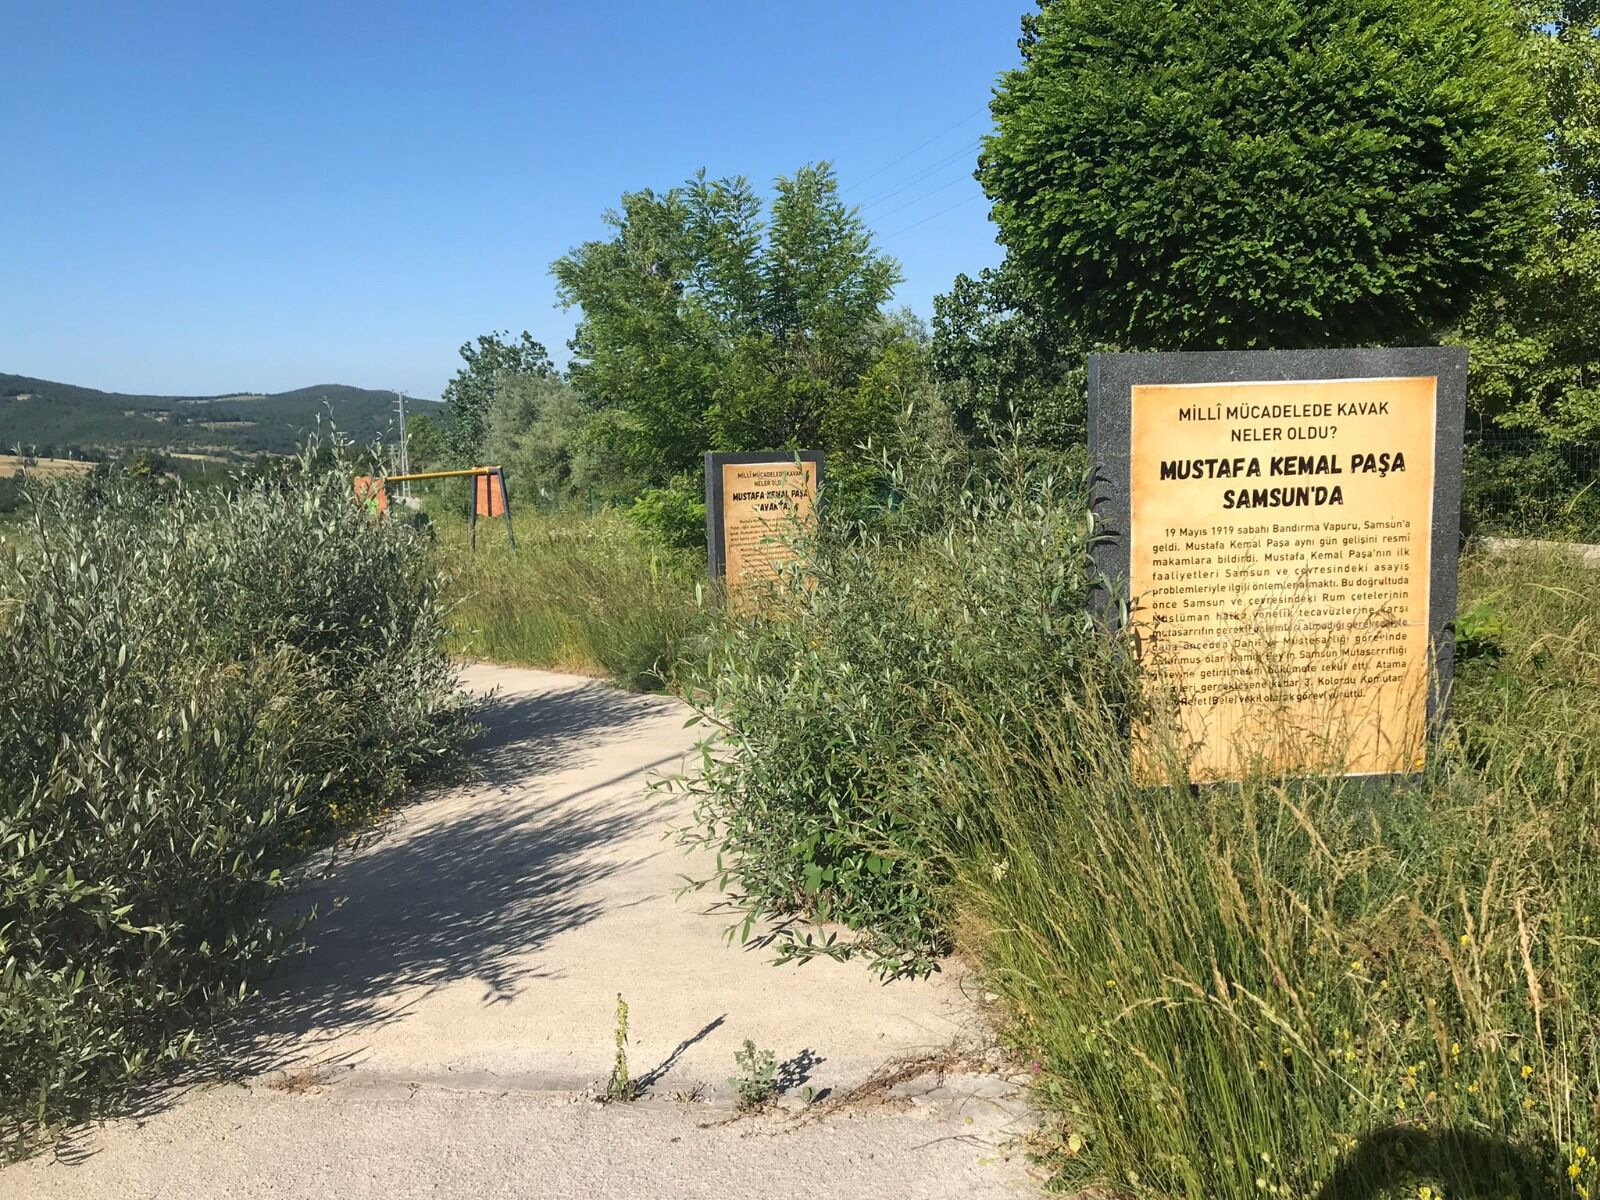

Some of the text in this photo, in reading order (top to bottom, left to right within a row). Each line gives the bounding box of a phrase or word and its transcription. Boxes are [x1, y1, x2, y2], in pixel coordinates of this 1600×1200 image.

[1178, 401, 1390, 421] MİLLÎ MÜCADELEDE KAVAK
[1231, 426, 1338, 442] NELER OLDU?
[1160, 452, 1406, 480] MUSTAFA KEMAL PAŞA
[732, 491, 765, 501] MUSTAFA
[1222, 485, 1344, 509] SAMSUN'DA
[1165, 520, 1411, 538] 19 Mayıs 1919 sabahı Bandırma Vapuru, Samsun'a
[1152, 543, 1181, 554] geldi.
[1185, 541, 1225, 551] Mustafa
[1230, 539, 1261, 549] Kemal
[1266, 538, 1290, 549] Paşa
[1294, 538, 1315, 548] aynı
[1320, 536, 1338, 547] gün
[1342, 535, 1378, 546] gelişini
[1152, 547, 1410, 566] makamlara bildirdi. Mustafa Kemal Paşa'nın ilk
[1152, 562, 1410, 581] faaliyetleri Samsun ve çevresindeki asayiş
[1152, 583, 1226, 597] problemleriyle
[1228, 582, 1251, 594] ilgili
[1341, 578, 1354, 587] Bu
[1356, 576, 1409, 588] doğrultuda
[1152, 600, 1177, 609] önce
[1183, 598, 1225, 608] Samsun
[1231, 598, 1243, 606] ve
[1322, 593, 1346, 602] Rum
[1351, 591, 1409, 602] çetelerinin
[1299, 650, 1338, 659] Samsun
[1376, 660, 1407, 669] Atama
[1318, 675, 1356, 686] Kolordu
